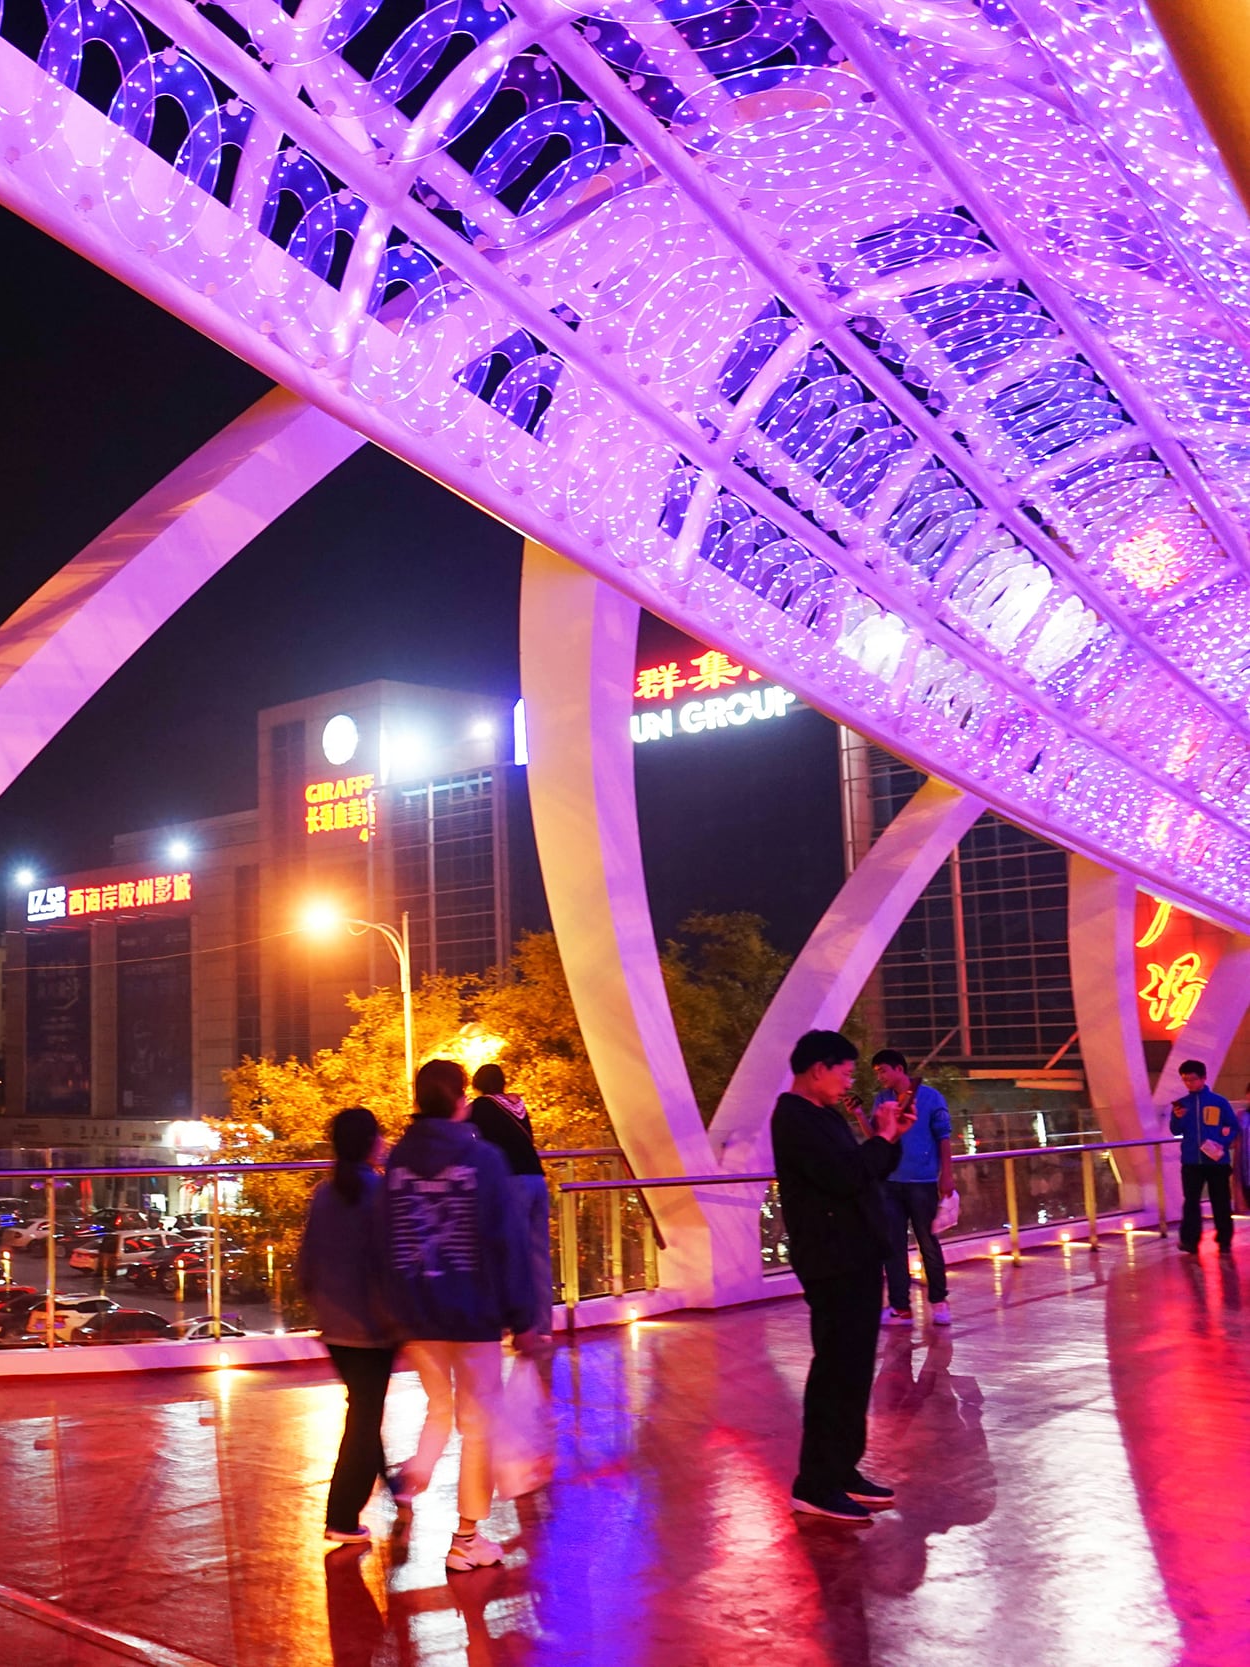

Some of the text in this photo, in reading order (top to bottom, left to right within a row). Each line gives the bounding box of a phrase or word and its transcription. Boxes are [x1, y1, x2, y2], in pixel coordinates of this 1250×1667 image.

[634, 650, 762, 700] 群集
[679, 685, 796, 734] GROUP
[68, 872, 192, 916] 西海岸胶州影城
